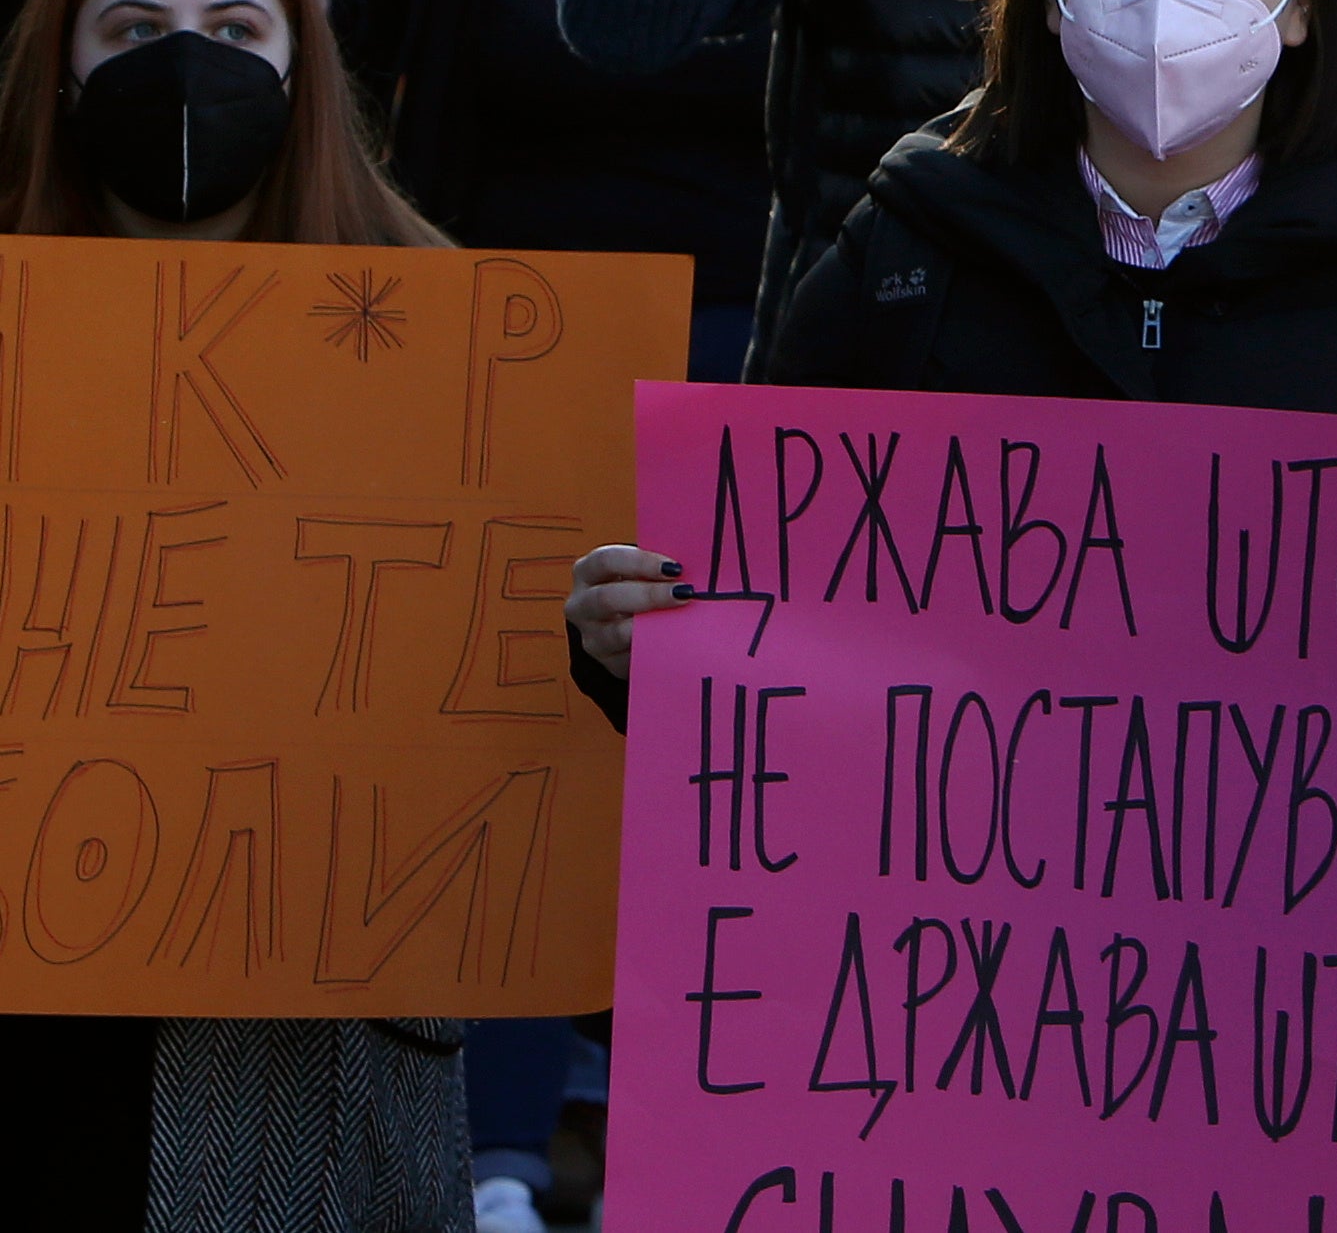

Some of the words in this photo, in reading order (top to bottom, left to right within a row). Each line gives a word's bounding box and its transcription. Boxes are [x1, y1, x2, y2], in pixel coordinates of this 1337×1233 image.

[875, 284, 927, 302] Wolfskin
[294, 514, 584, 726] ТЕ
[690, 423, 1137, 658] ДРЖАВА
[688, 675, 806, 874] НЕ
[685, 906, 766, 1096] Е
[808, 911, 1218, 1142] ДРЖАВА
